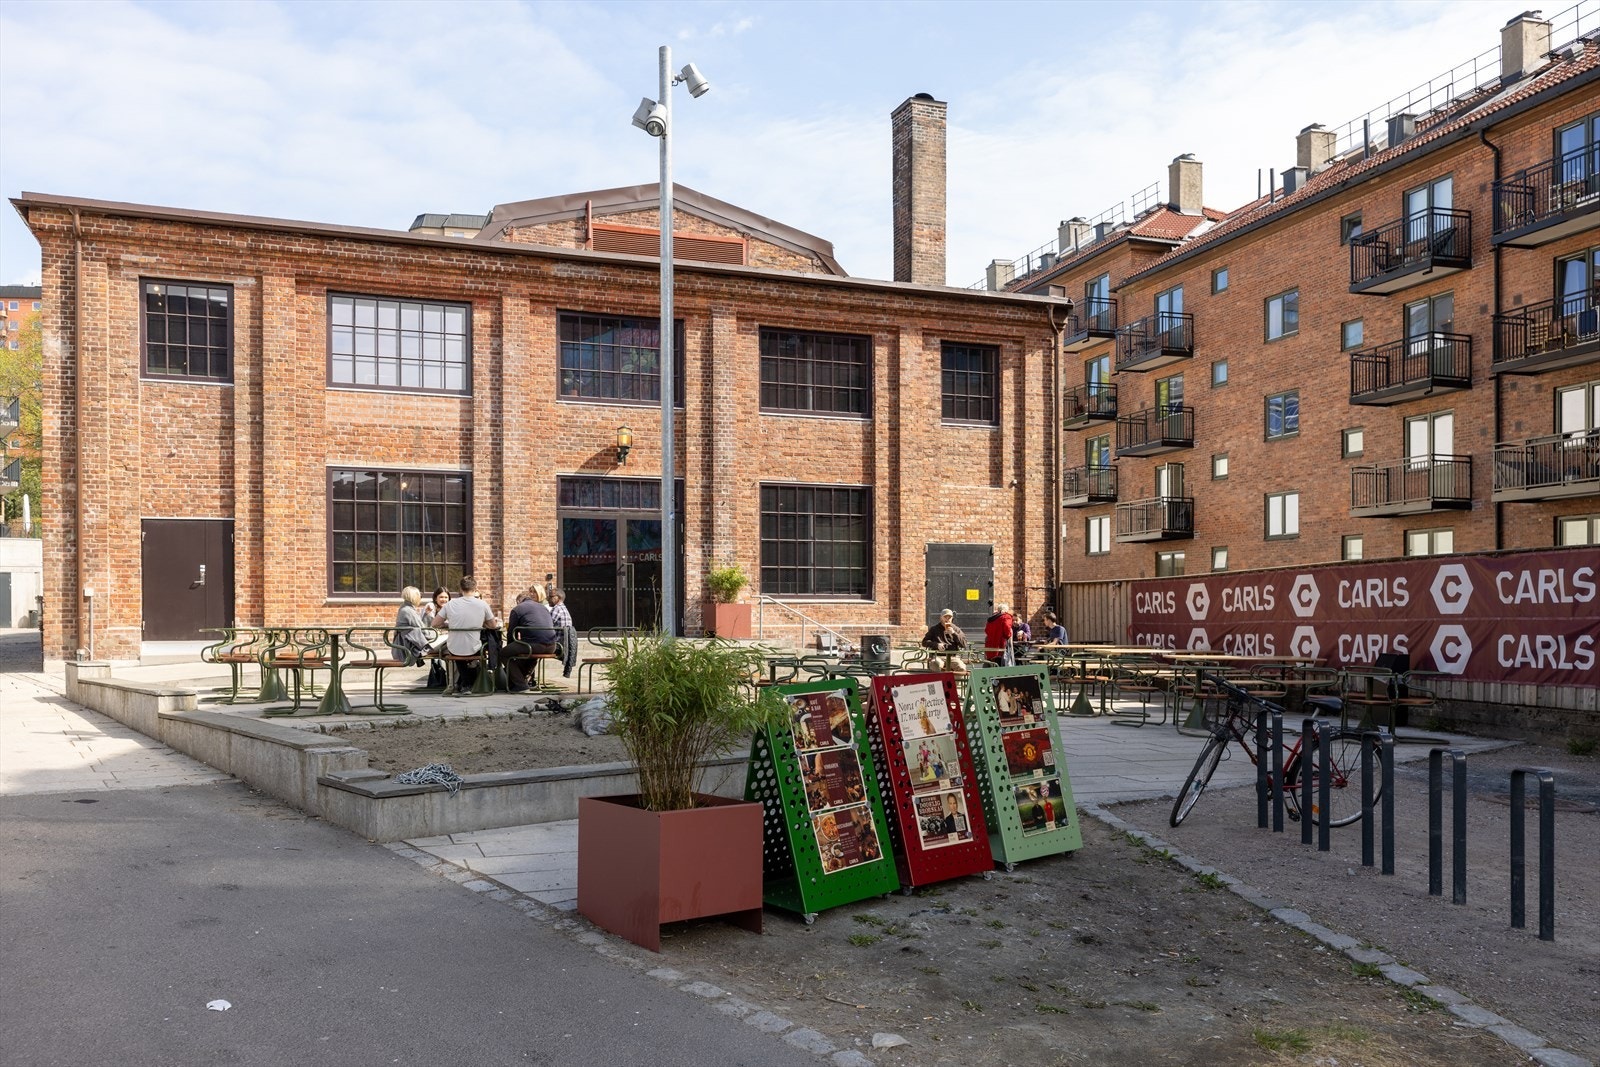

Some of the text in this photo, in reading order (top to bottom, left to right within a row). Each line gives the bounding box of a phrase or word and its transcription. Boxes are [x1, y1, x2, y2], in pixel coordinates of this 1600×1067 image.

[1136, 591, 1176, 614] CARLS
[1221, 584, 1275, 613] CARLS
[1338, 577, 1410, 609] CARLS
[1496, 567, 1596, 605] CARLS
[1223, 633, 1276, 657] CARLS
[1498, 634, 1596, 671] CARLS
[898, 702, 915, 712] Nora
